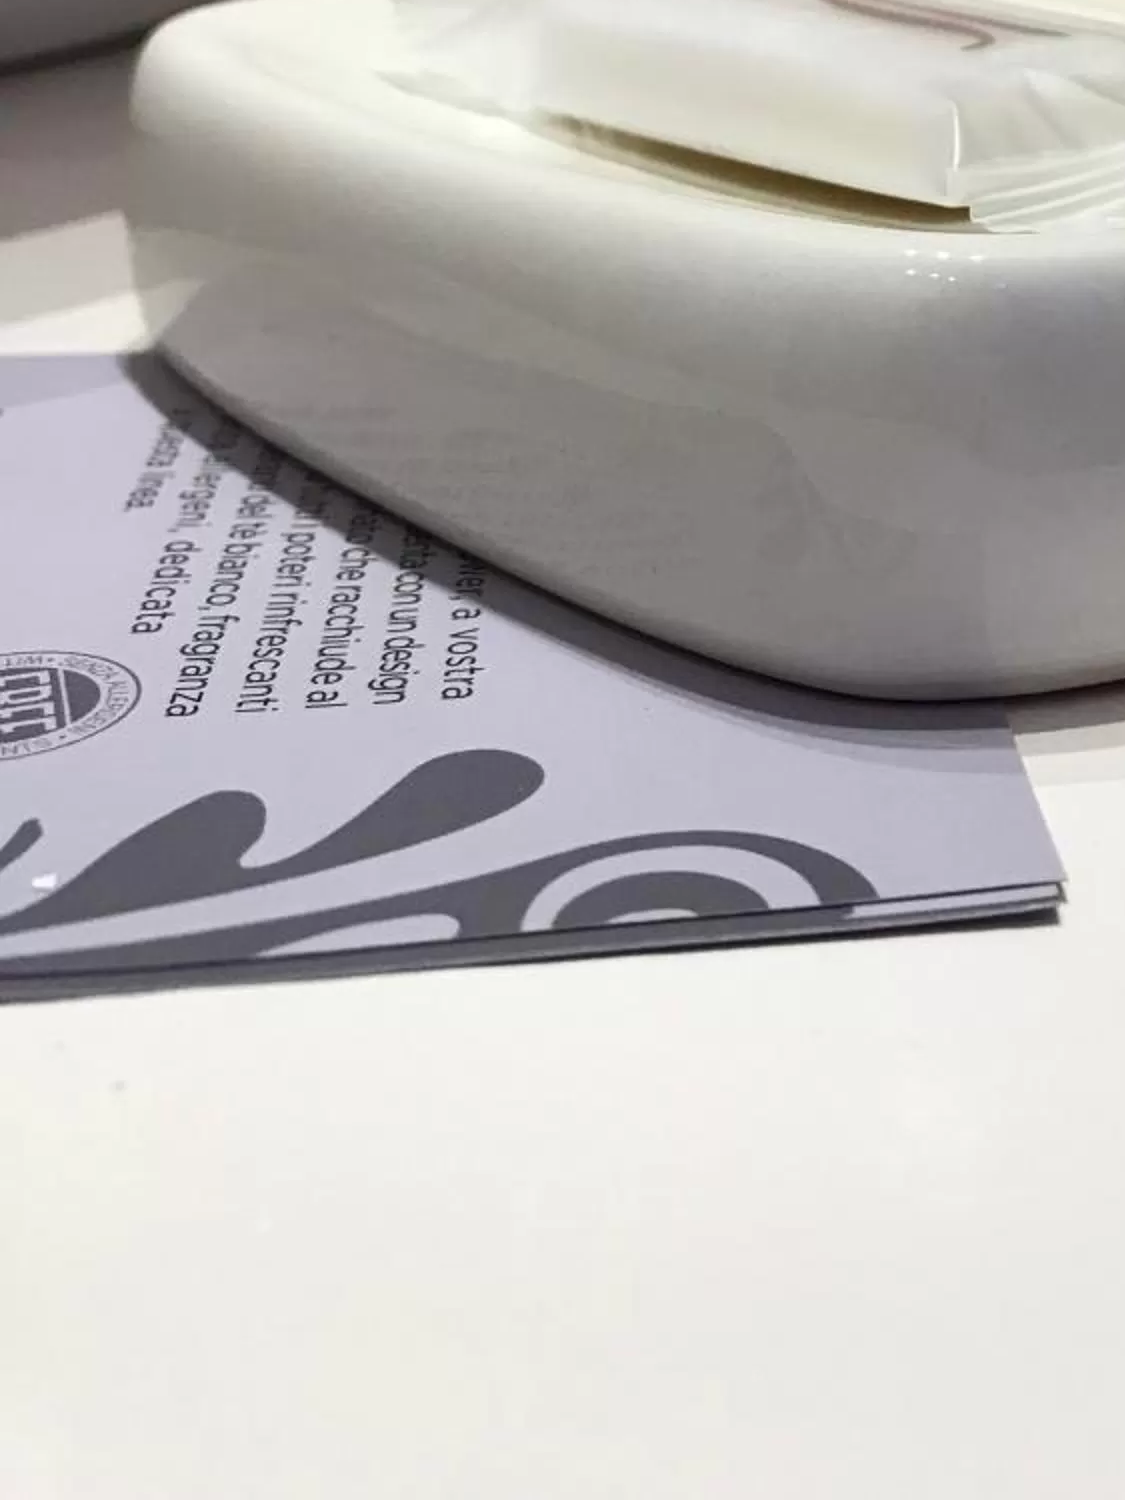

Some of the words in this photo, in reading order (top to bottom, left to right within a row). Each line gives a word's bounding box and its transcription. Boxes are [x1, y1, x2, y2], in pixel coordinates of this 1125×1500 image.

[132, 539, 204, 635] dedicata
[198, 542, 263, 612] bianco,
[273, 530, 317, 589] poteri
[165, 613, 241, 718] fragranza
[234, 592, 308, 714] rinfrescanti
[314, 584, 362, 687] racchiude
[368, 635, 426, 706] design
[441, 627, 486, 702] vostra
[305, 691, 349, 710] al
